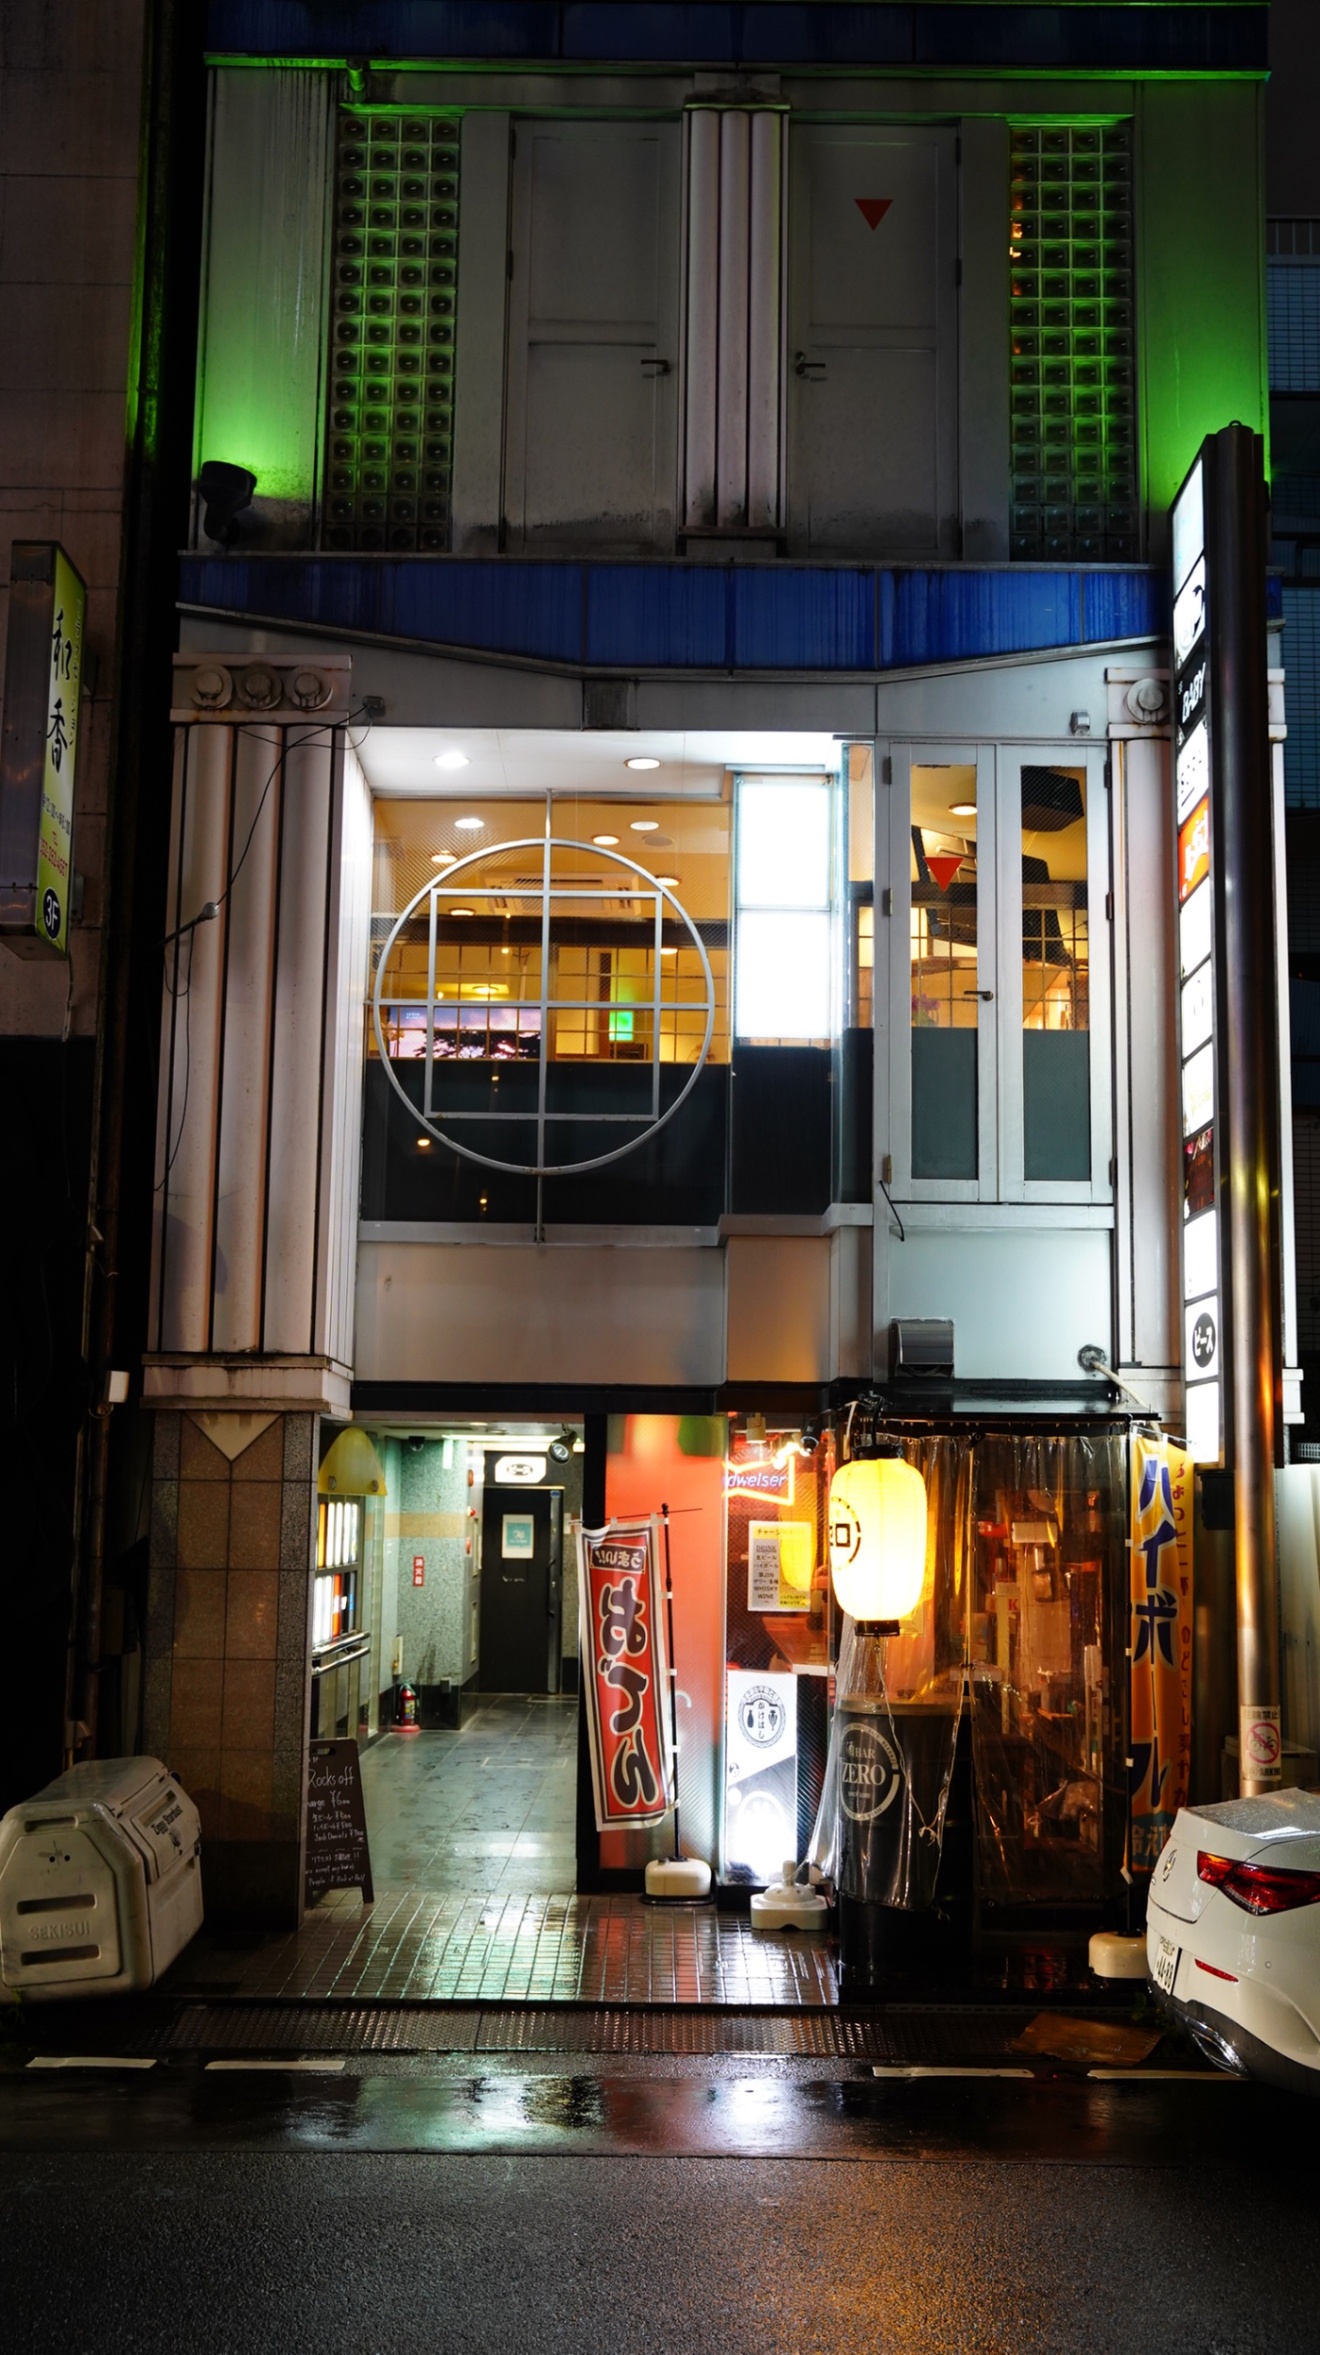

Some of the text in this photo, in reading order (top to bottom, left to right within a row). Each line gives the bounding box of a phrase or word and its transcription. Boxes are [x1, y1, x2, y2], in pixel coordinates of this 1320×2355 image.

[1182, 662, 1207, 722] BABY
[45, 894, 60, 932] 3F
[415, 1558, 423, 1585] 消火器
[757, 1701, 765, 1740] かけはし
[338, 1765, 355, 1787] off
[842, 1761, 886, 1786] ZERO
[28, 1920, 90, 1942] SEKISUI
